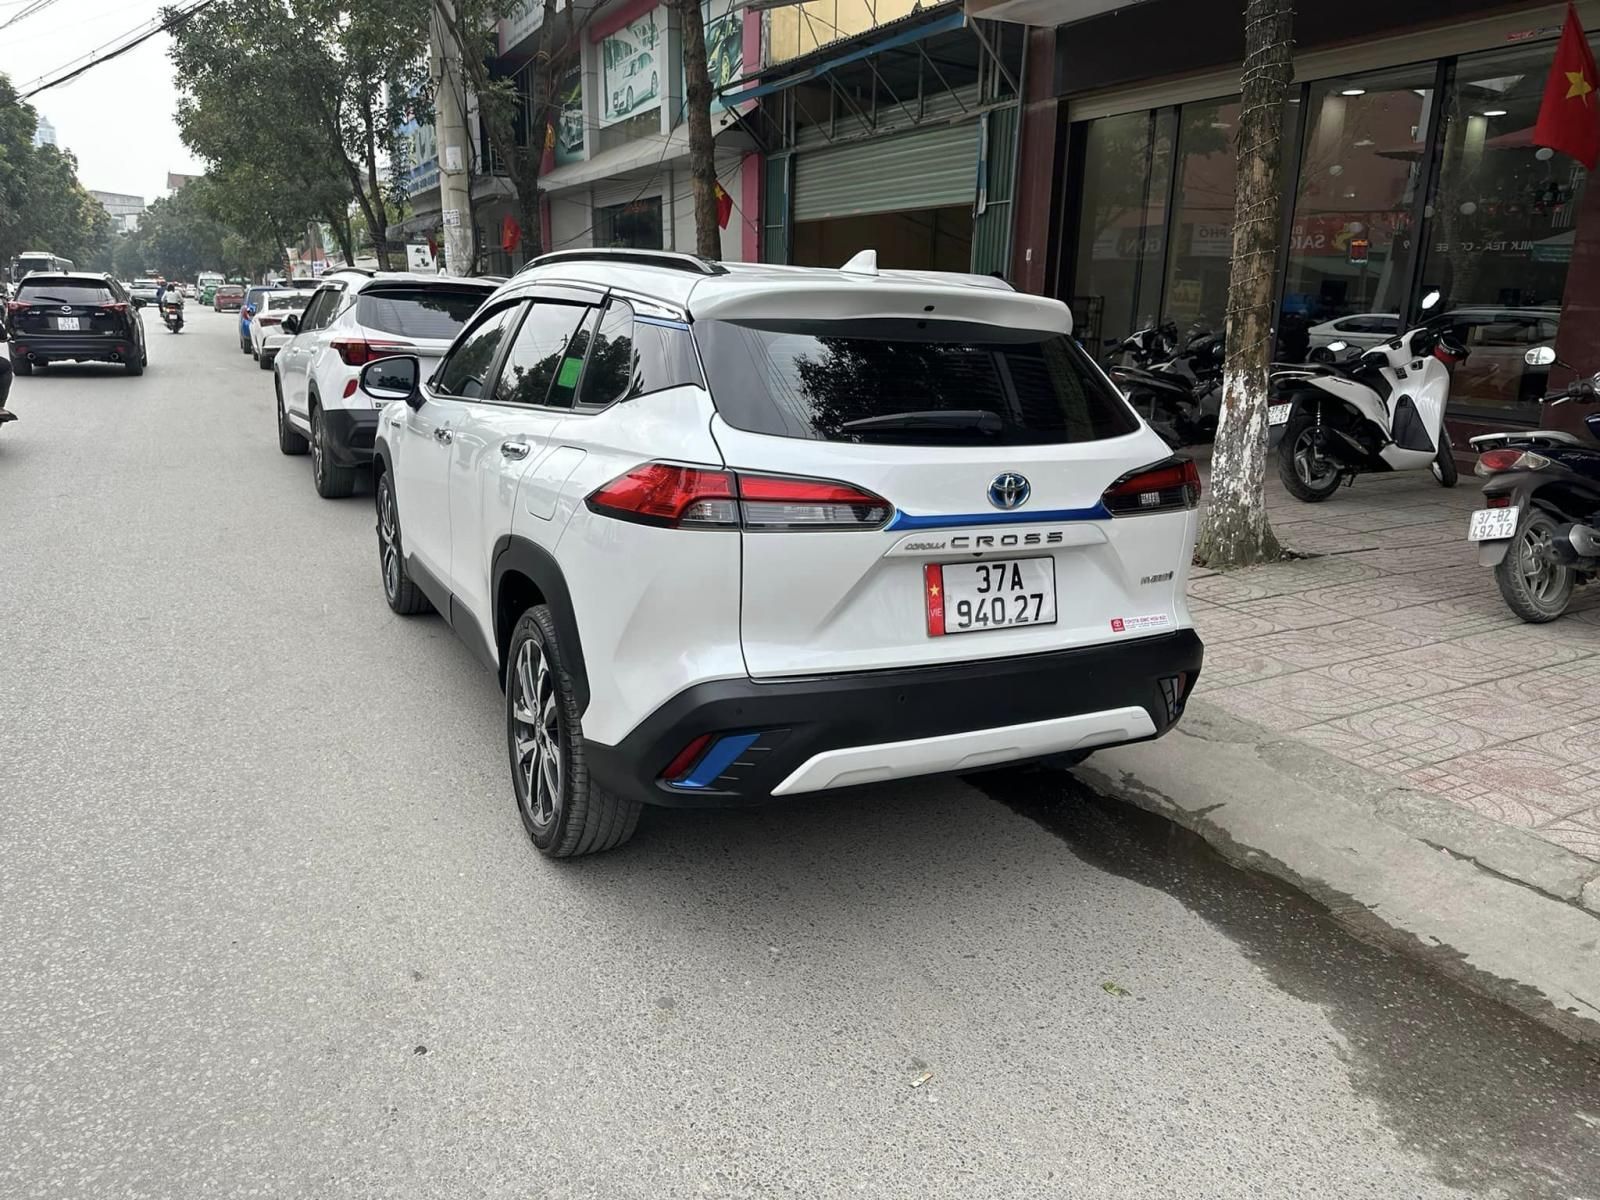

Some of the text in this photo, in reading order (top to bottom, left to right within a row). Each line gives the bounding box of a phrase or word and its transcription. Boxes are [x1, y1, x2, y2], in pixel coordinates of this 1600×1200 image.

[1472, 523, 1512, 538] 492.12
[904, 531, 1063, 550] COROLLA CROSS
[976, 562, 1024, 594] 37A
[930, 608, 943, 617] VIE
[957, 593, 1043, 629] 940.27
